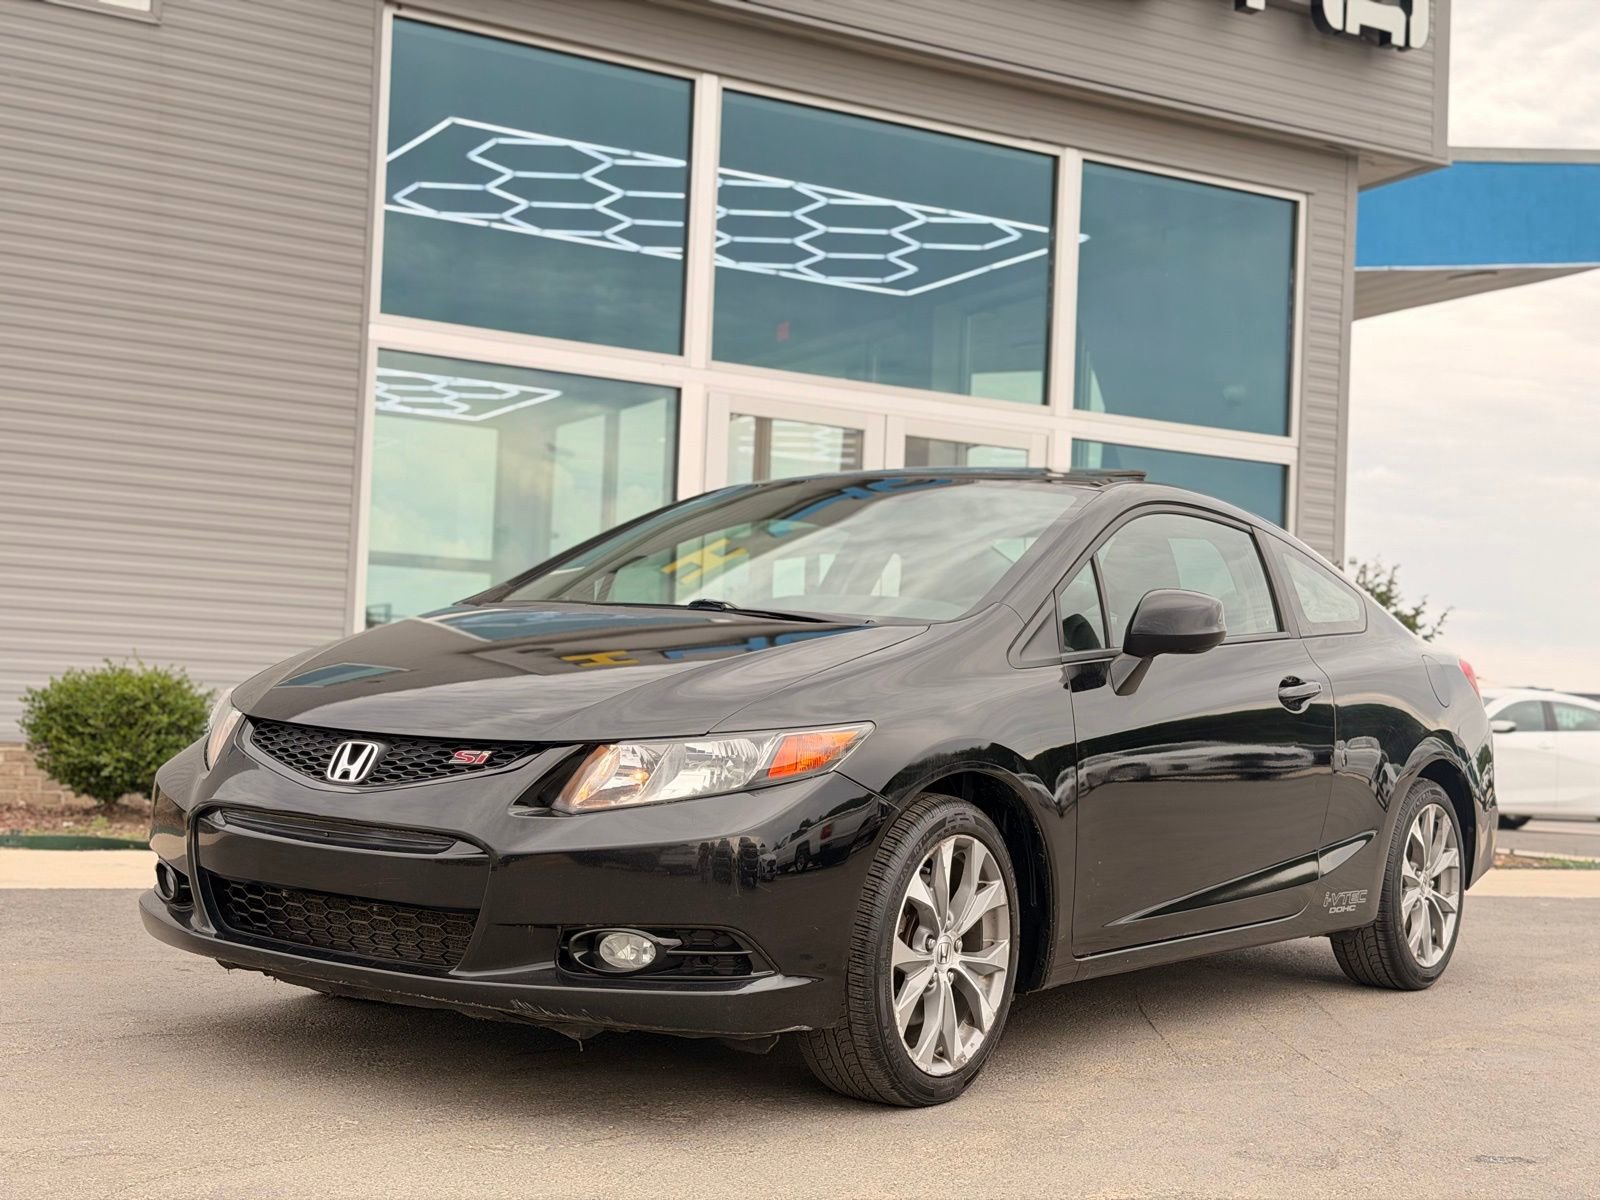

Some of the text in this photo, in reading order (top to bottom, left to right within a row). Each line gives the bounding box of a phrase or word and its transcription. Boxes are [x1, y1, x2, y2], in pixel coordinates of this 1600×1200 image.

[449, 751, 491, 764] Si
[1323, 889, 1368, 907] i-VTEC
[1329, 905, 1356, 913] DOHC
